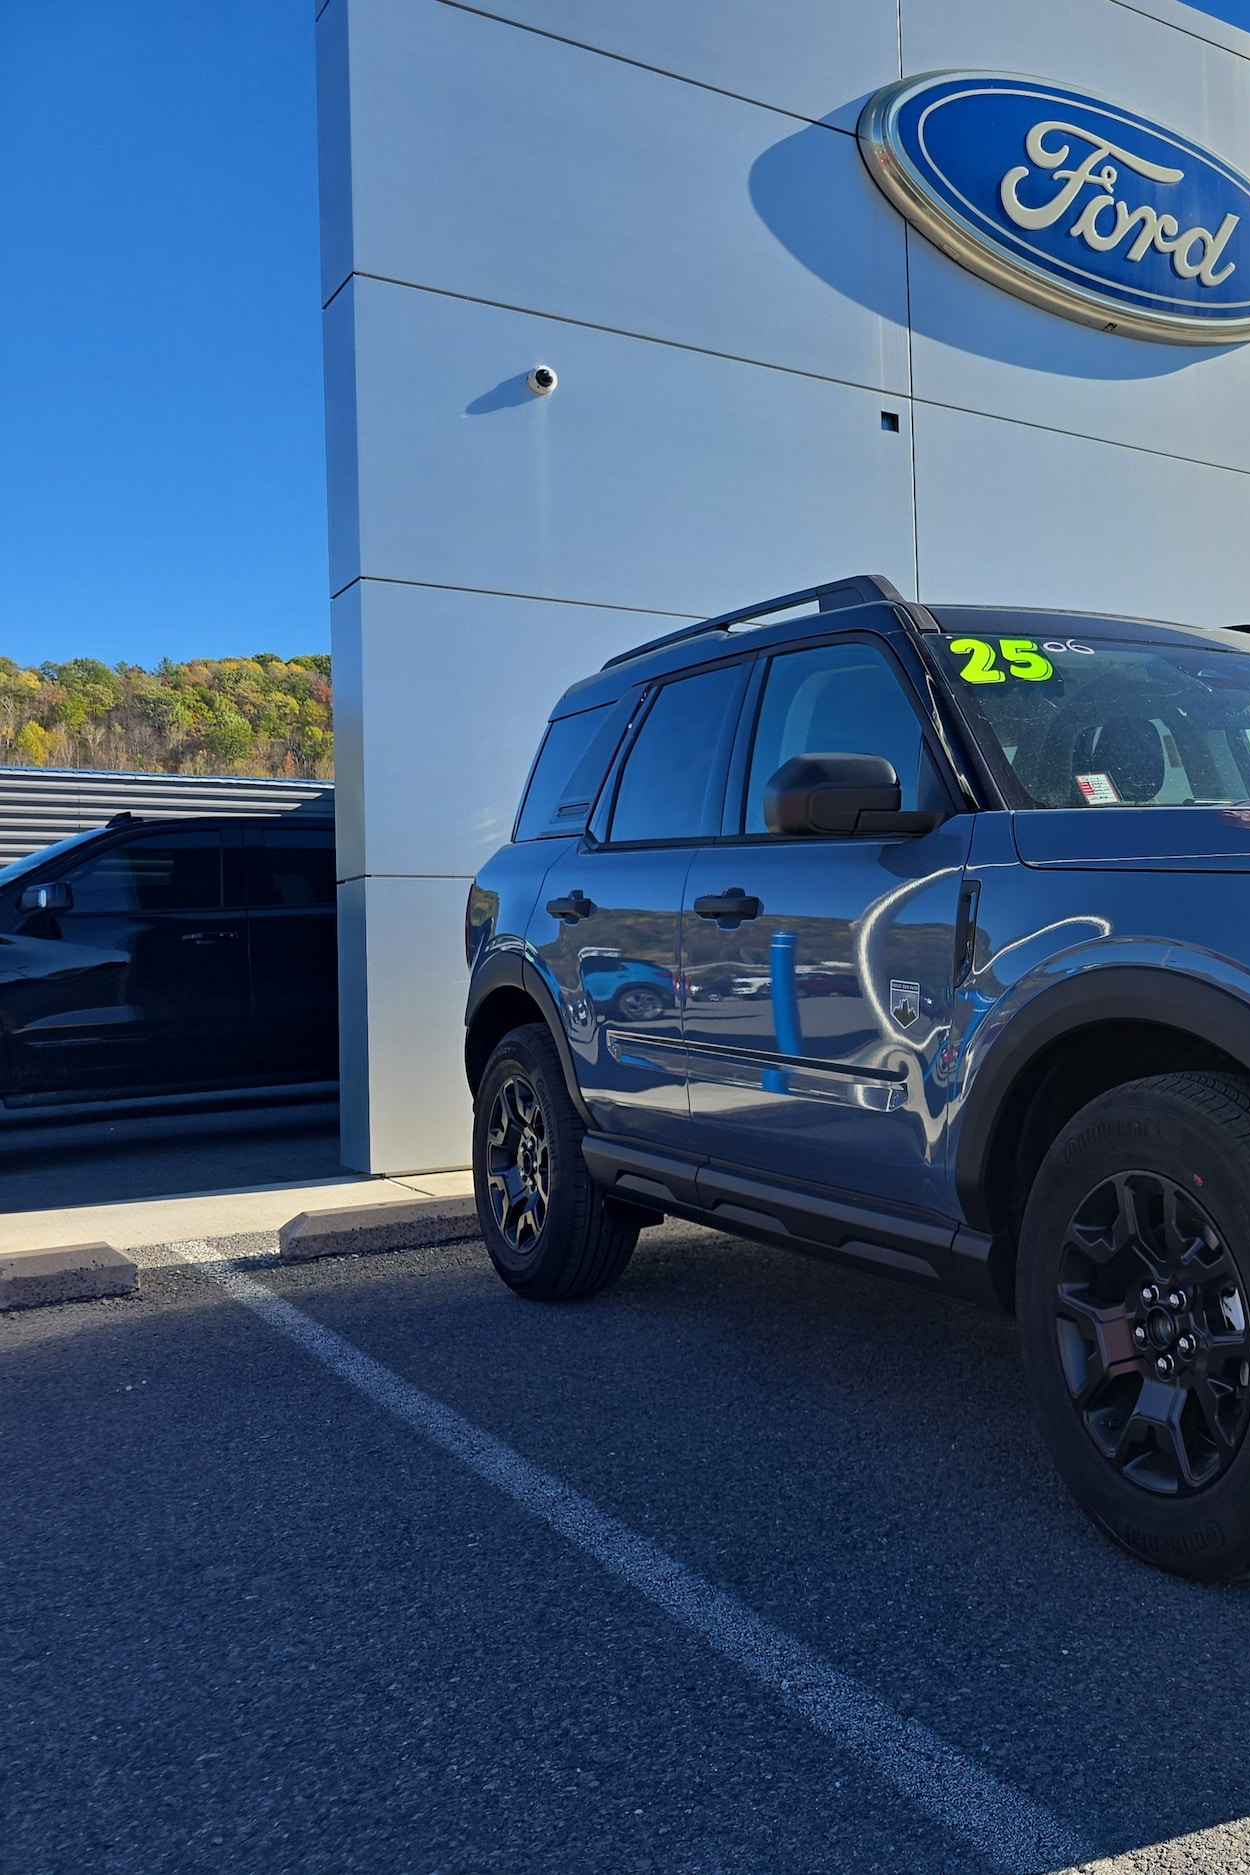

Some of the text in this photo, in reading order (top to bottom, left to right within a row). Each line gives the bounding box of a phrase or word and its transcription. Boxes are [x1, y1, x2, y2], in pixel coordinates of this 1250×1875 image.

[1001, 121, 1239, 288] Ford
[949, 638, 1053, 683] 25
[1063, 1117, 1149, 1166] Continental
